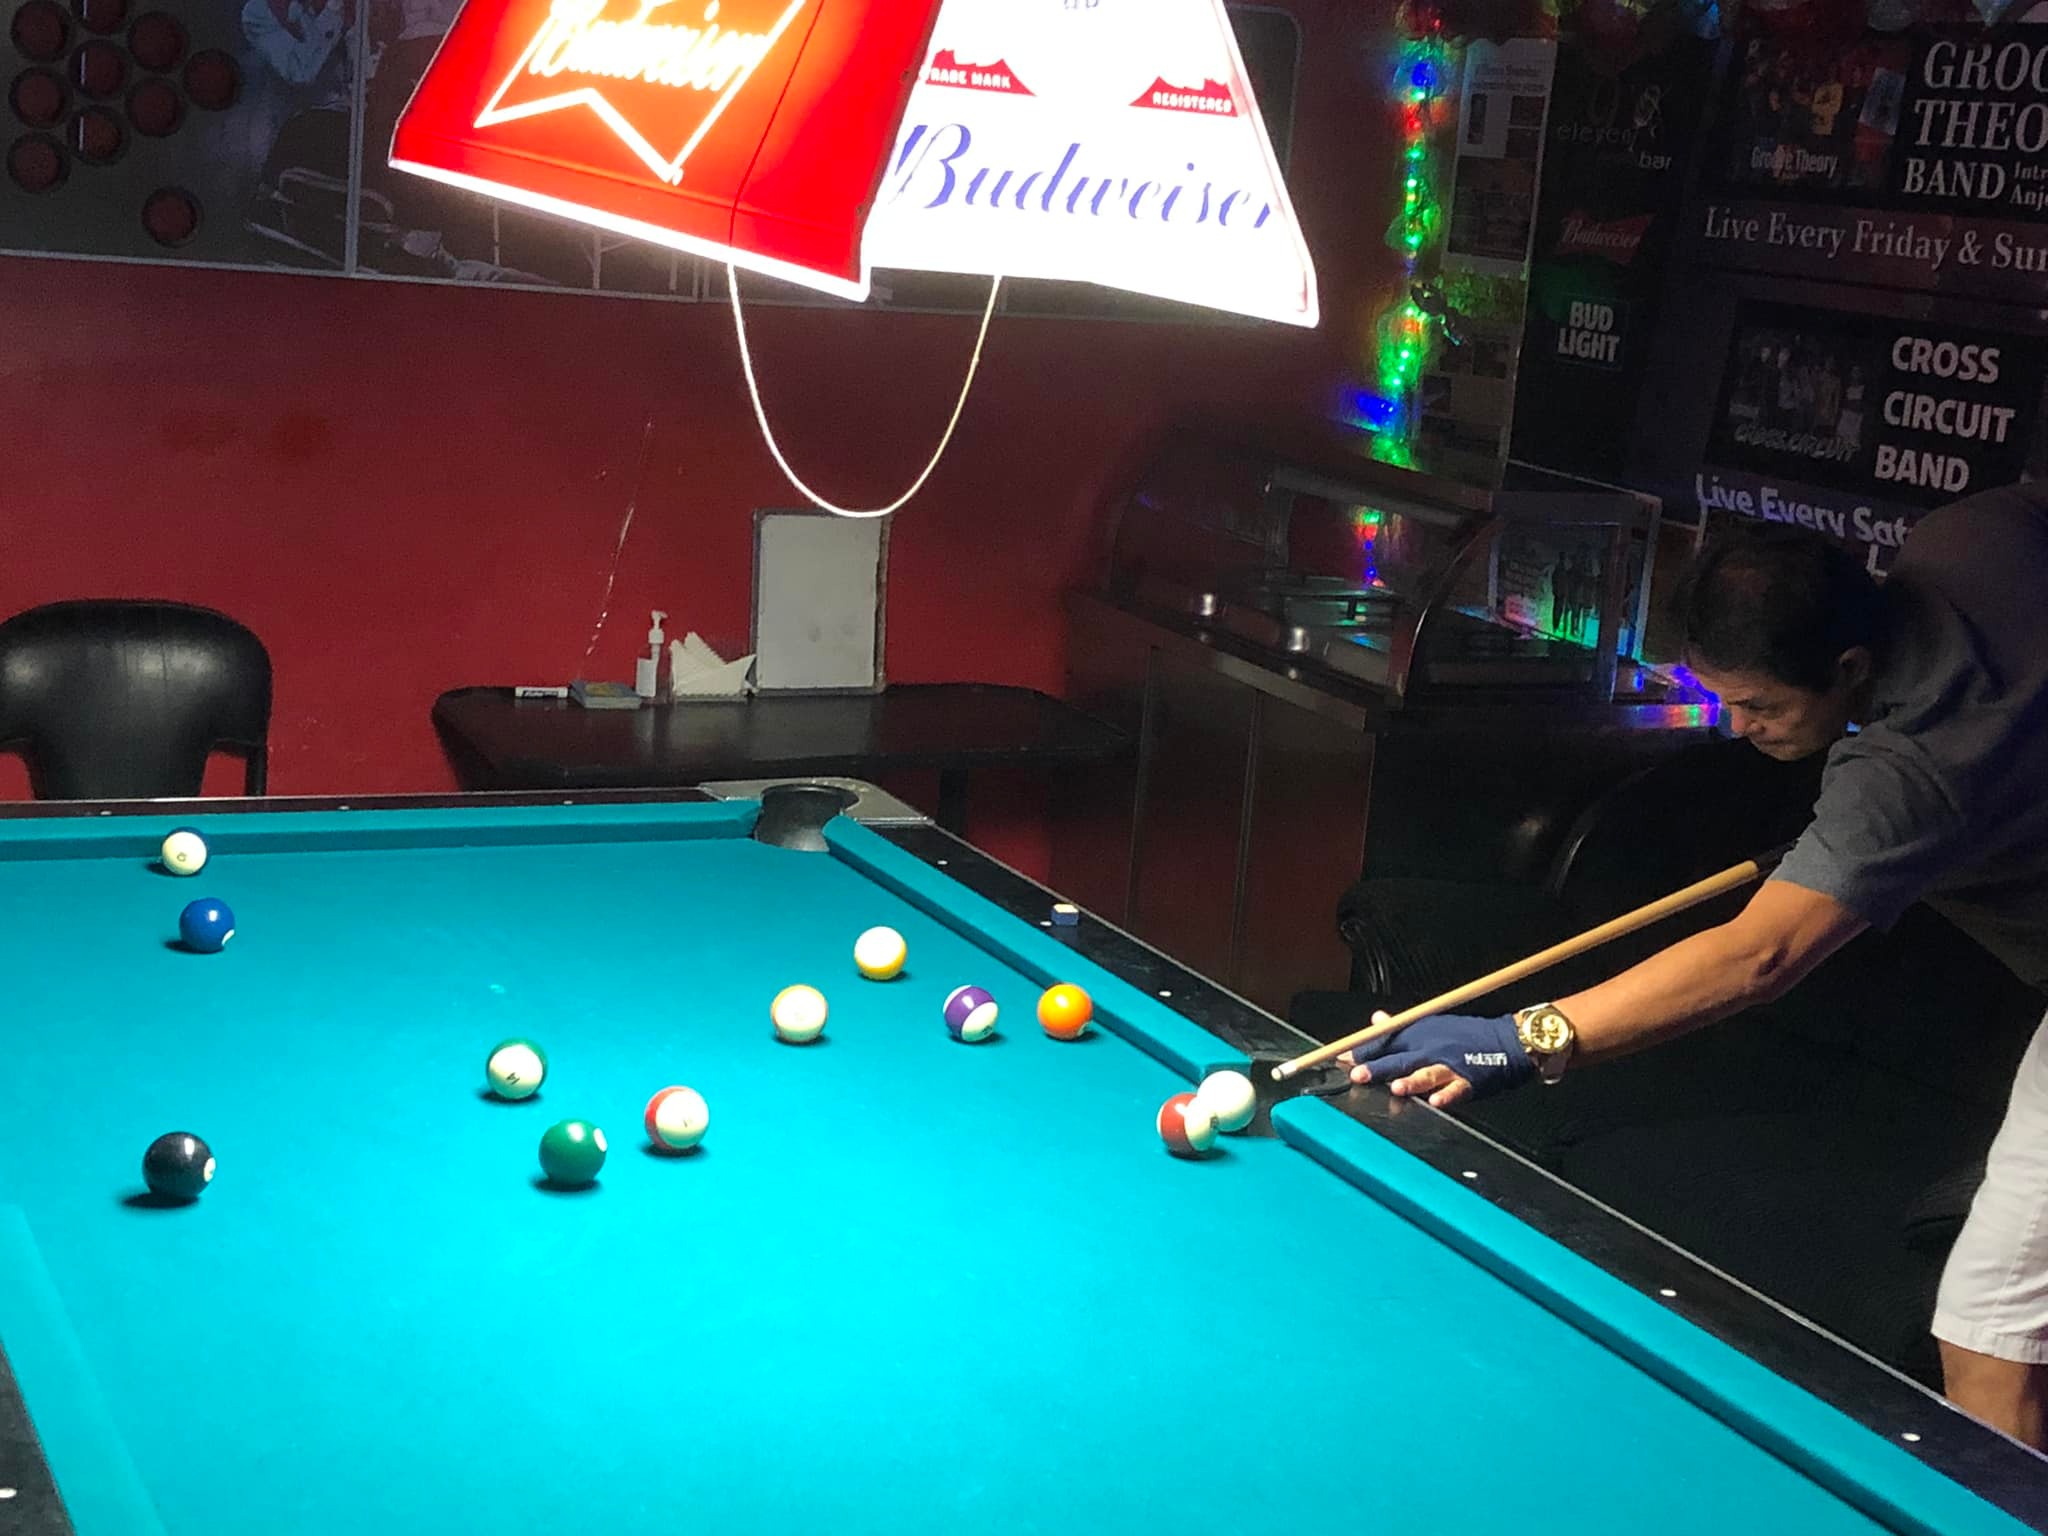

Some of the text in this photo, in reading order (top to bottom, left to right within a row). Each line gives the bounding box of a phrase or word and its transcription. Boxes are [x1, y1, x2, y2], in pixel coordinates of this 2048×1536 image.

[971, 72, 1011, 89] MARK
[1152, 91, 1232, 113] REGISTERED
[1903, 158, 2006, 200] BAND
[1705, 206, 1760, 243] Live
[1767, 211, 1846, 258] Every
[1852, 219, 1951, 269] Friday
[1958, 230, 1985, 265] &
[1569, 301, 1614, 332] BUD
[1558, 327, 1620, 363] LIGHT
[1892, 336, 2000, 384] CROSS
[1884, 391, 2016, 443] CIRCUIT
[1875, 444, 1970, 493] BAND
[1696, 473, 1912, 548] Live Every Sat
